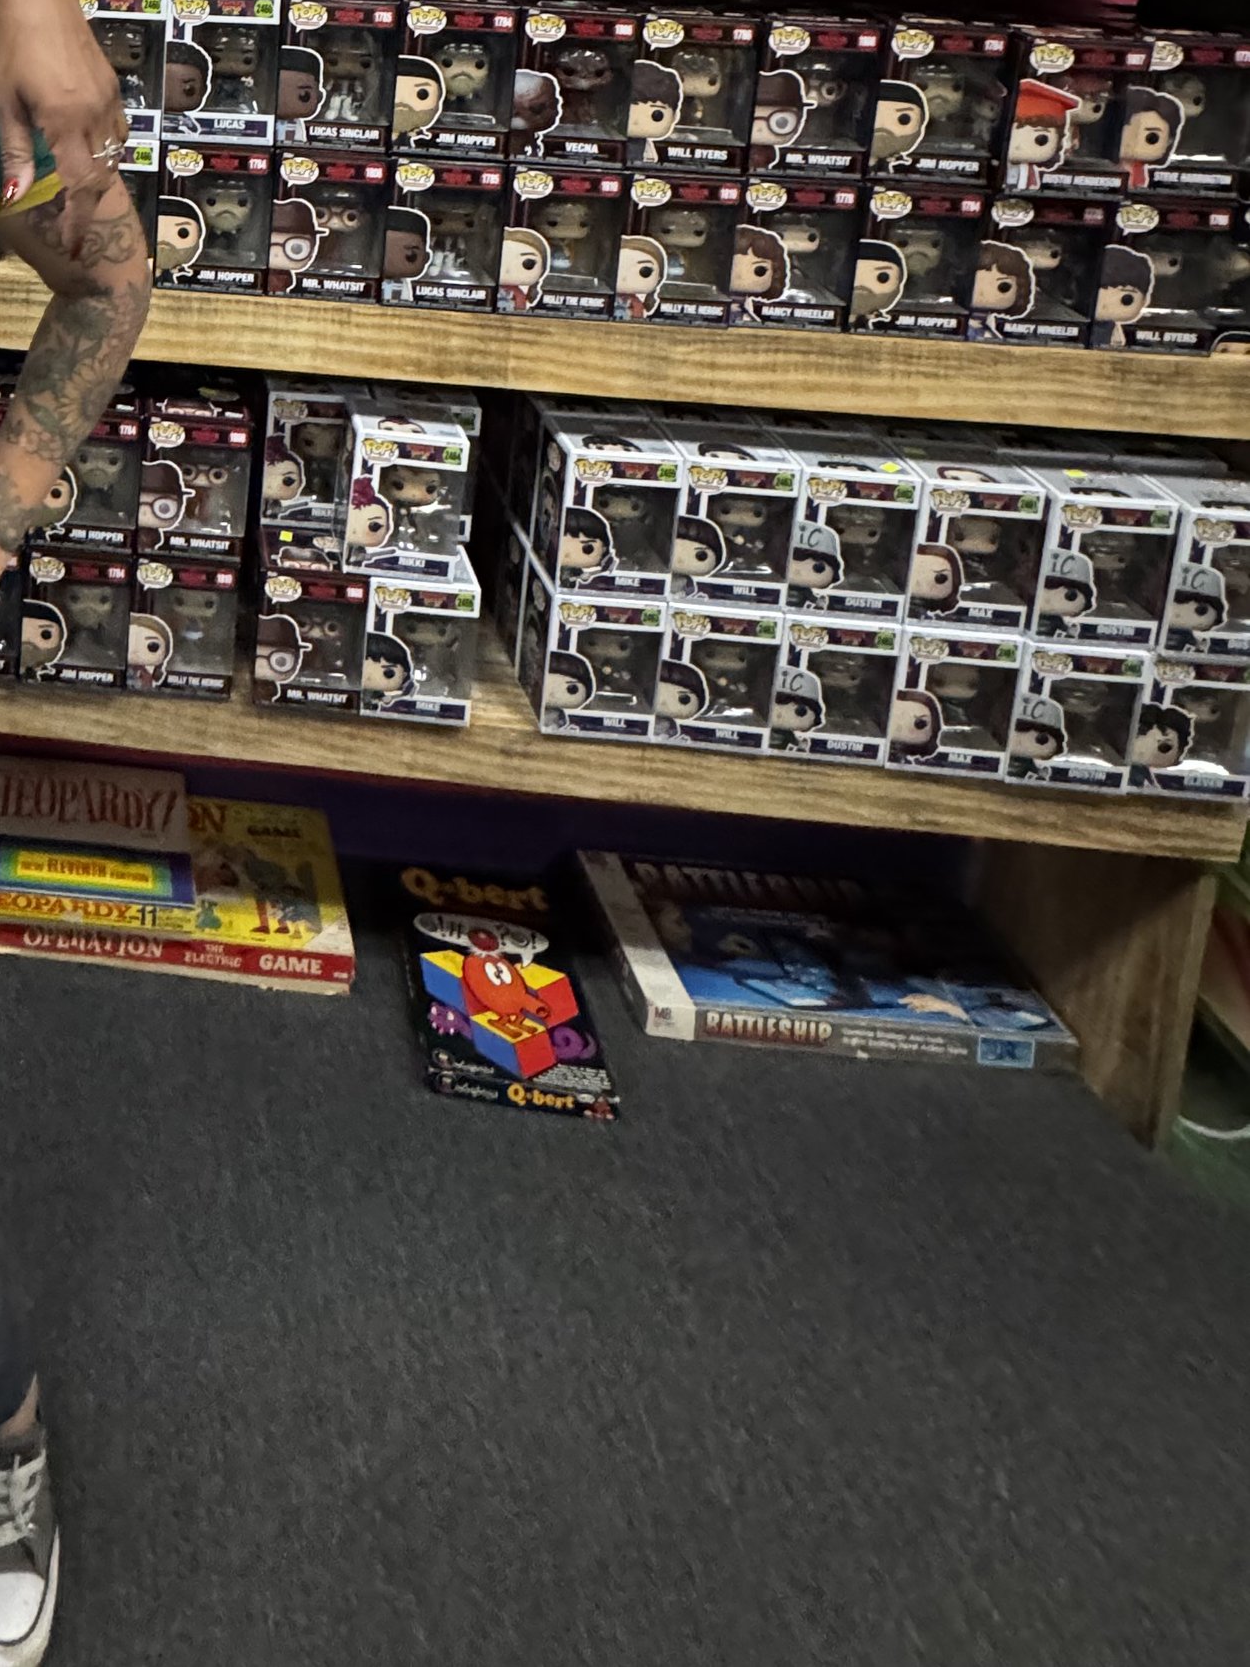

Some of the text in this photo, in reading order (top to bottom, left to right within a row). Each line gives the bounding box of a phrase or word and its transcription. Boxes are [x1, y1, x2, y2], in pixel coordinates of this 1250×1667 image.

[290, 2, 327, 22] POP!
[213, 118, 246, 130] LUCAS
[308, 125, 379, 140] LUCAS SINCLAIR
[435, 132, 496, 147] JIM HOPPER
[565, 142, 599, 154] VECNA
[667, 147, 728, 162] WILL BYERS
[167, 149, 204, 169] POP!
[785, 153, 853, 167] MR. WHATSIT
[915, 157, 980, 173] JIM HOPPER
[197, 270, 256, 284] JIM HOPPER
[302, 277, 366, 292] MR. WHATSIT
[415, 284, 486, 300] LUCAS SINCLAIR
[761, 305, 835, 320] NANCY WHEELER
[895, 316, 958, 330] JIM HOPPER
[69, 528, 124, 543] JIM HOPPER
[169, 536, 230, 551] MR. WHATSIT
[398, 556, 426, 568] NIKKI
[614, 575, 641, 588] MIKE
[732, 584, 758, 597] WILL
[844, 597, 883, 610] DUSTIN
[59, 668, 114, 683] JIM HOPPER
[286, 688, 348, 704] MR. WHATSIT
[602, 716, 627, 728] WILL
[715, 728, 739, 740] WILL
[827, 739, 864, 752] DUSTIN
[23, 921, 164, 960] OPERATION
[258, 952, 323, 977] GAME
[705, 1010, 833, 1046] BATTLESHIP
